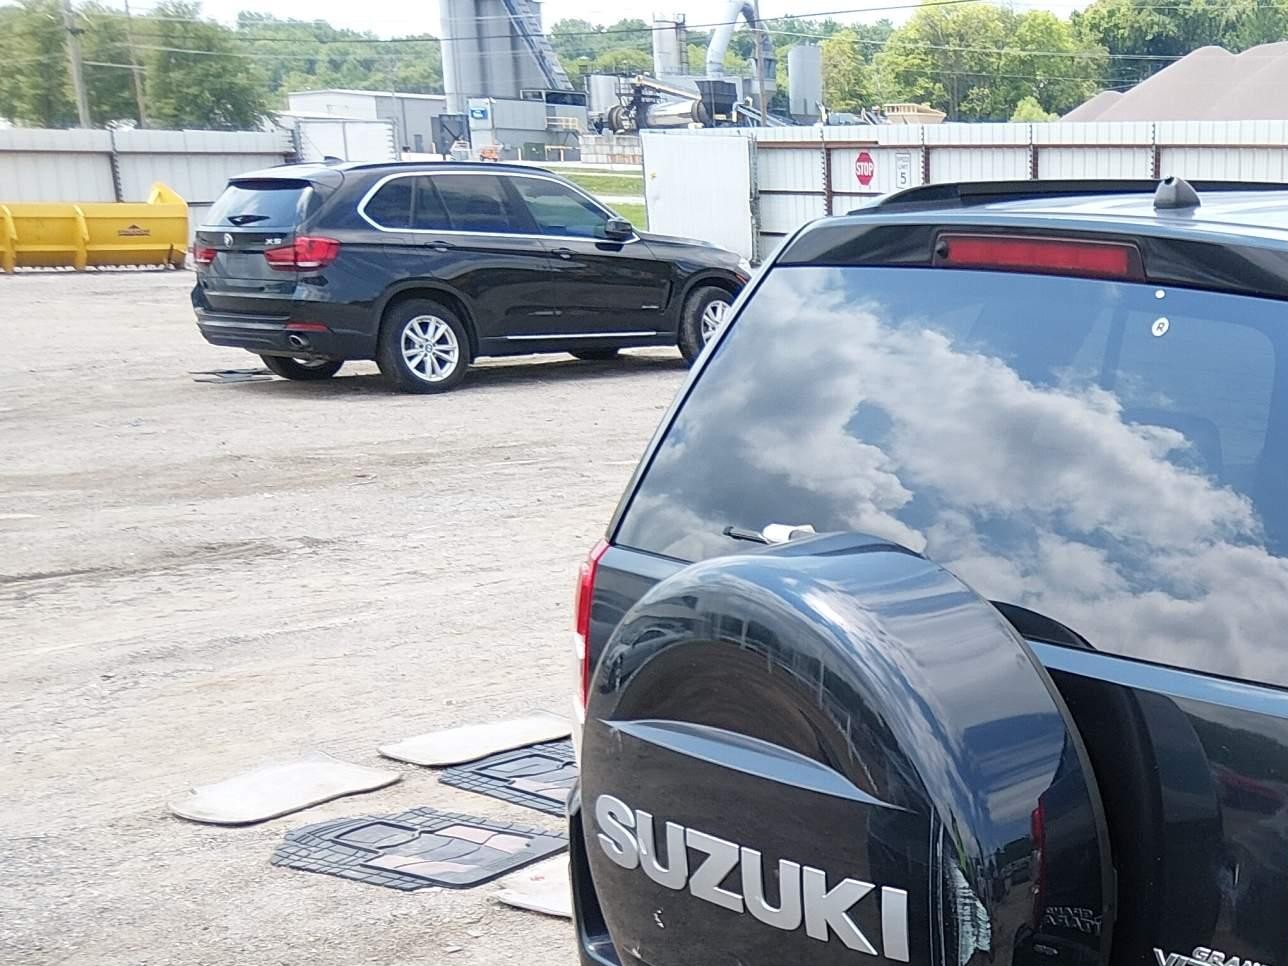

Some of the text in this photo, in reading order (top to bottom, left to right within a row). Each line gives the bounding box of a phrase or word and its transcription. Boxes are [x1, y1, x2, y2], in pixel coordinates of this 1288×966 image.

[856, 162, 874, 176] STOP
[900, 171, 907, 185] 5
[595, 794, 909, 963] SUZUKI
